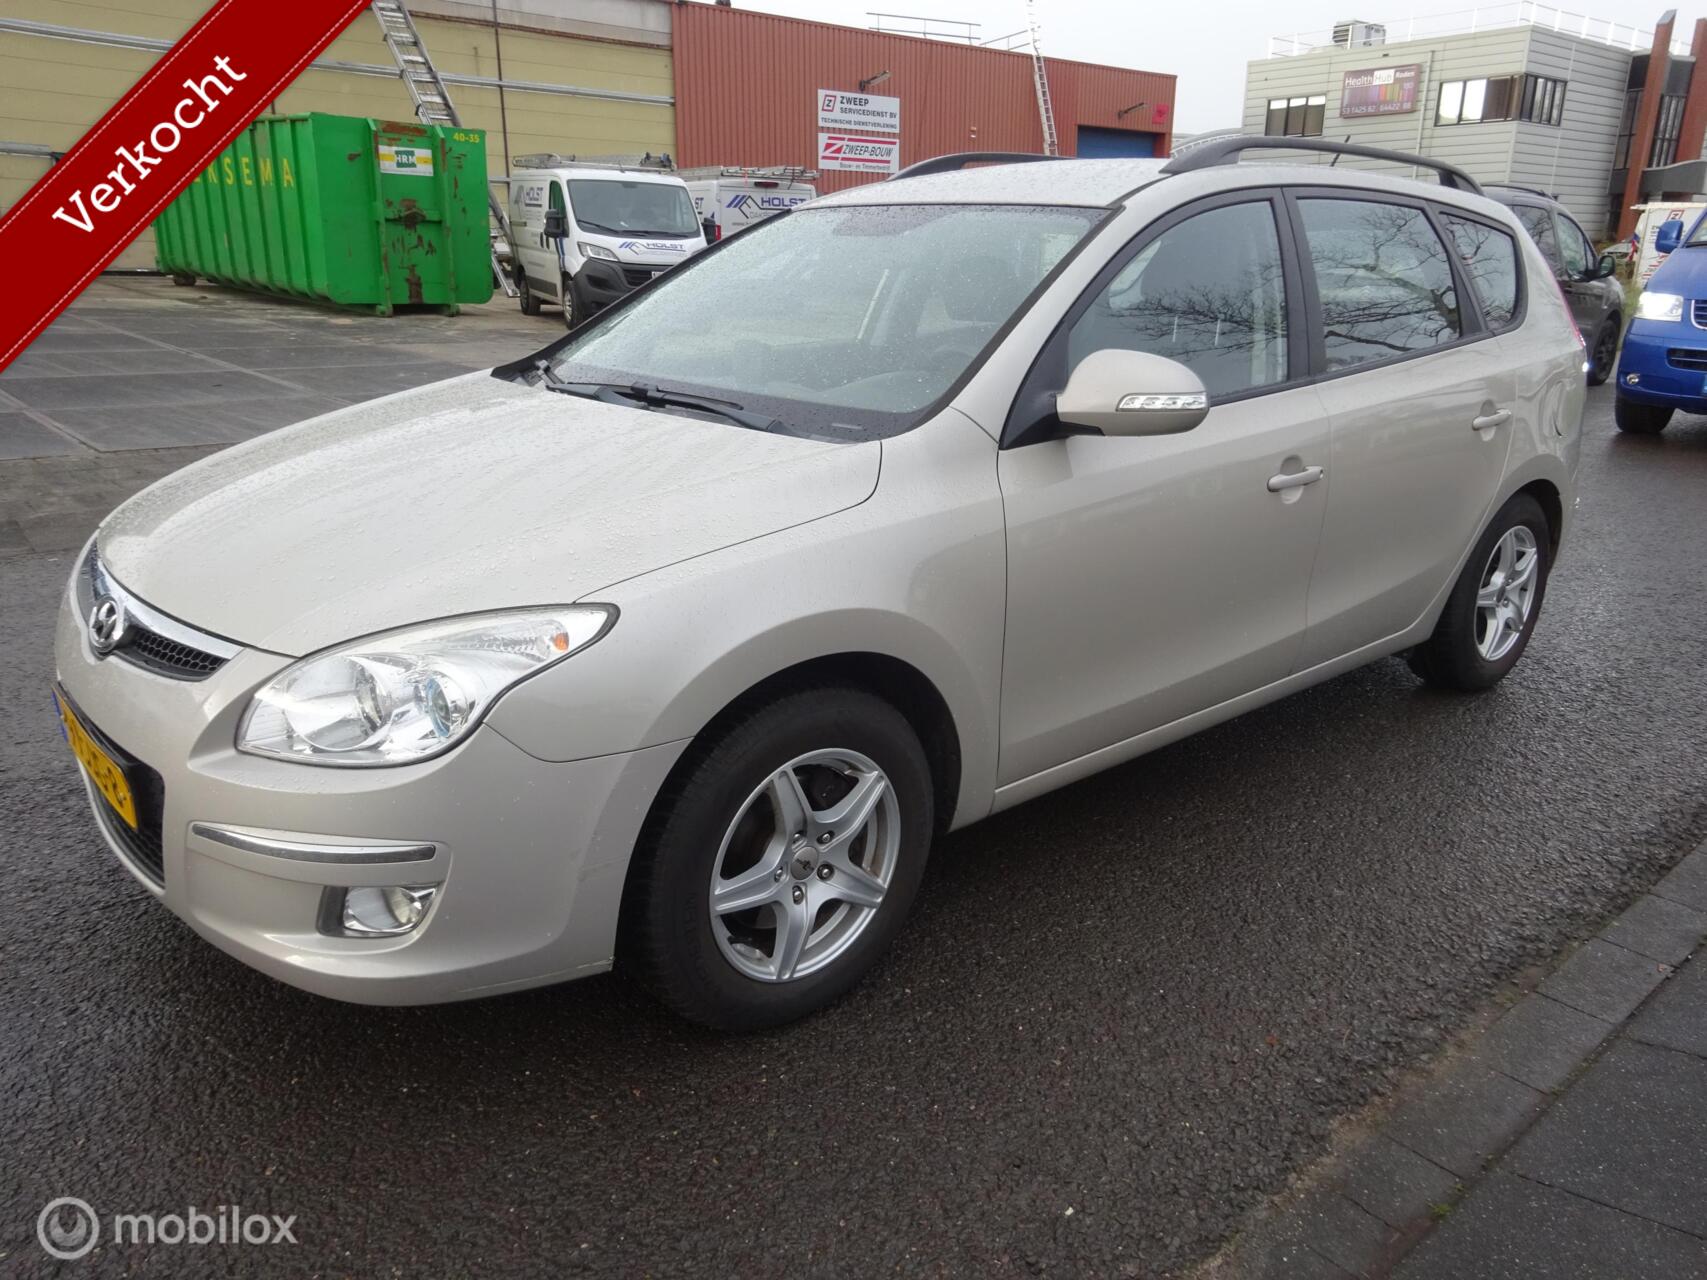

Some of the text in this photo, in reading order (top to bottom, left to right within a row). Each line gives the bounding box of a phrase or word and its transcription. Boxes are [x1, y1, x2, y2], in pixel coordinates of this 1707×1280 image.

[840, 96, 869, 106] ZWEEP
[840, 107, 897, 119] SERVICEDIENST BV
[842, 144, 893, 158] ZWEEP-BOUW
[395, 154, 416, 165] HRM
[646, 242, 684, 250] HOLST
